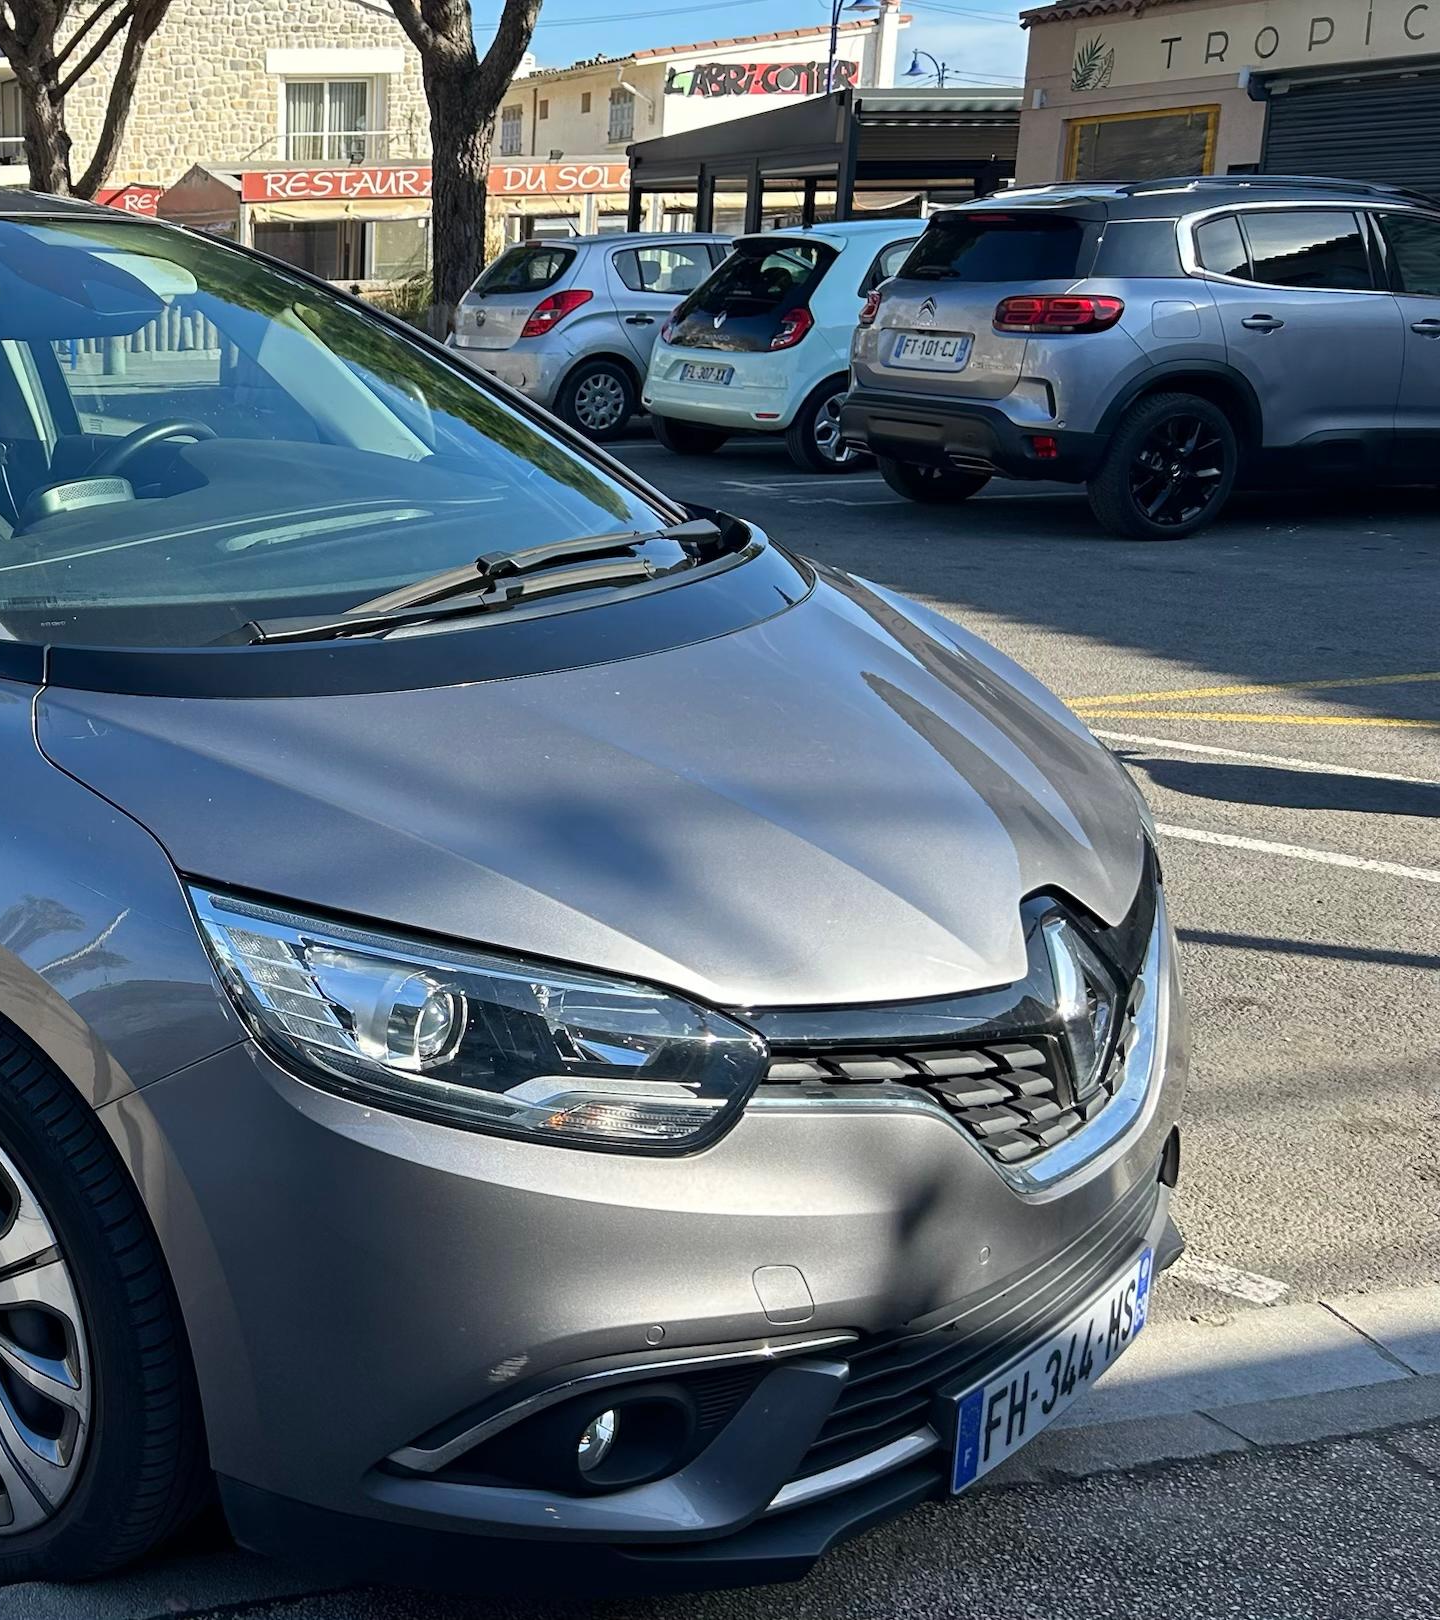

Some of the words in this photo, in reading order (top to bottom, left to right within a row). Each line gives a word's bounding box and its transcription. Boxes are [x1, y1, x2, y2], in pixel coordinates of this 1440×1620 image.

[504, 167, 547, 192] DU
[902, 338, 960, 358] FT-101-CJ
[963, 1447, 973, 1468] F
[983, 1279, 1136, 1462] FH-344-HS
